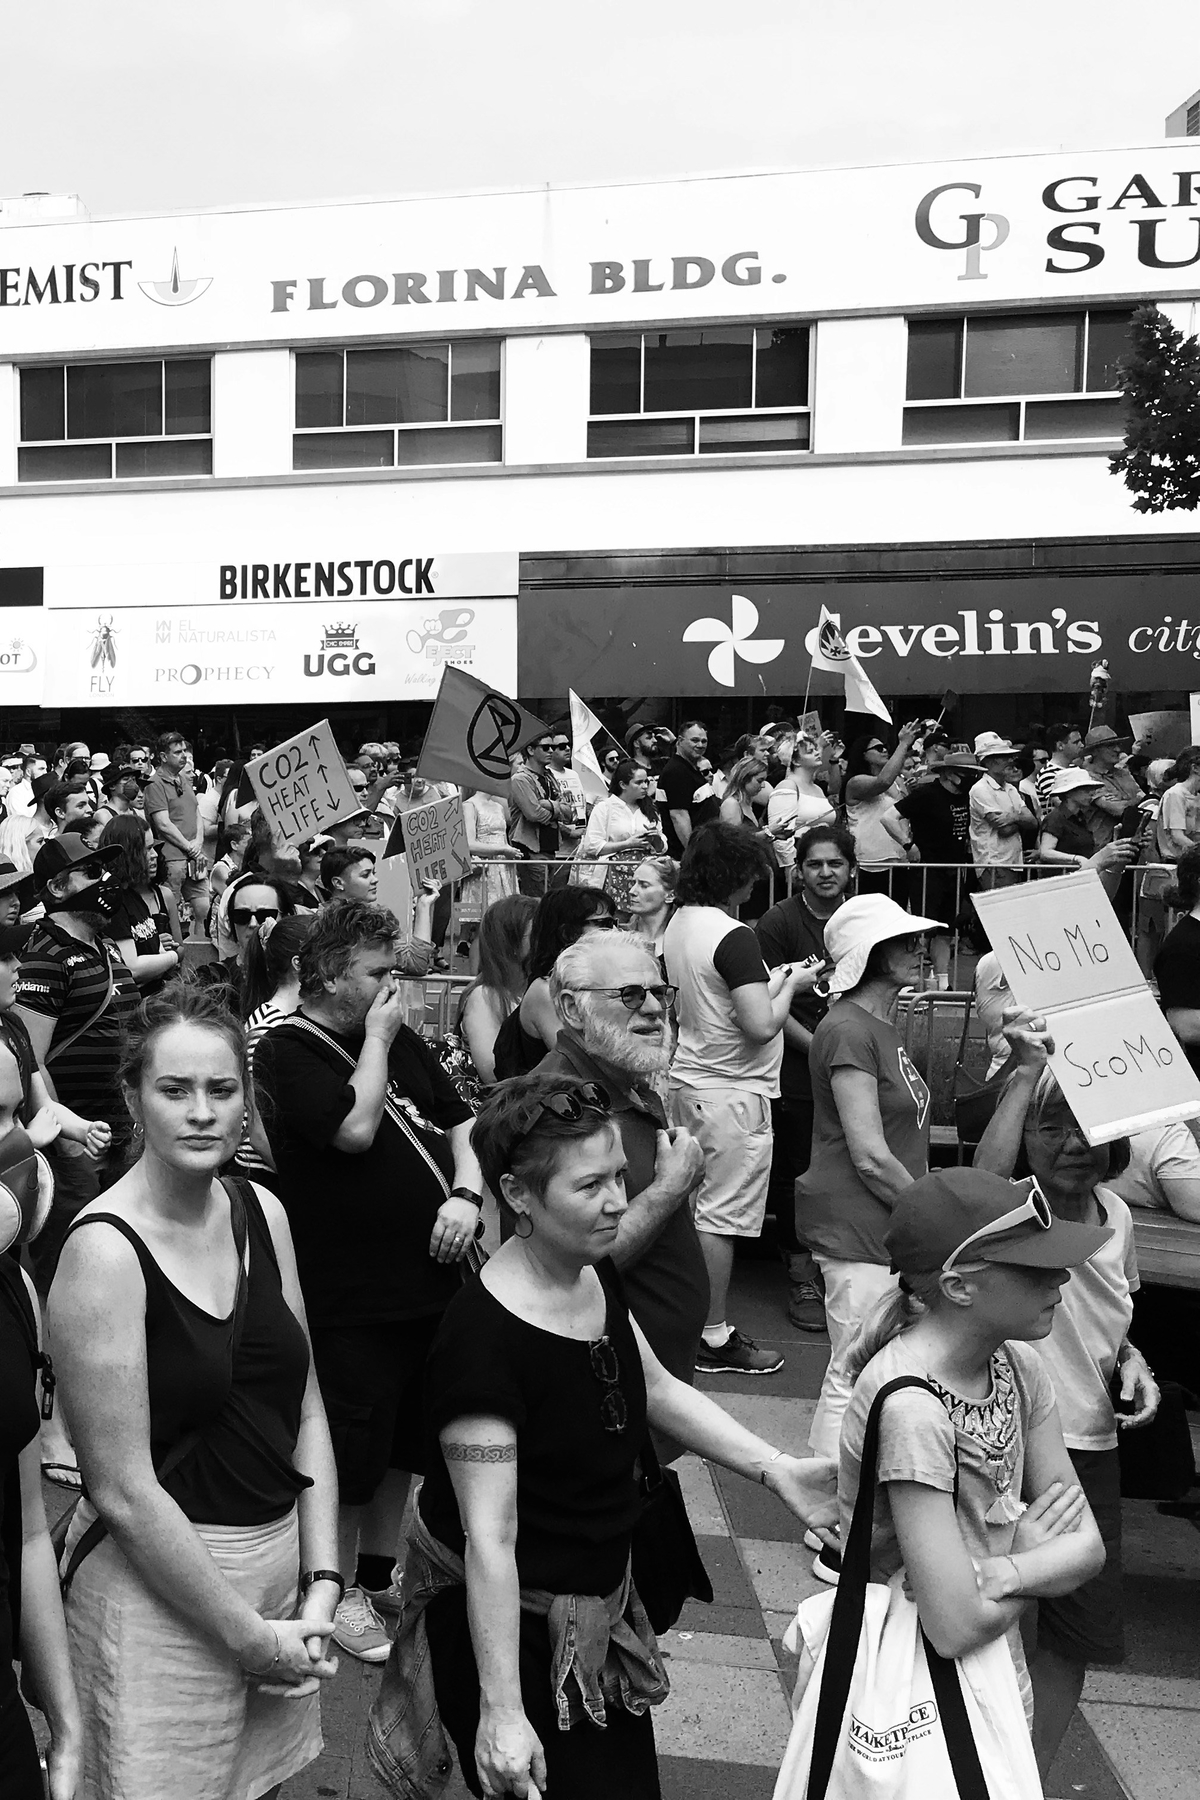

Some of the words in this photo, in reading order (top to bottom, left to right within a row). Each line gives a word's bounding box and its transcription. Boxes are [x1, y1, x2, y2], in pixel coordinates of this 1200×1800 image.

[270, 264, 557, 313] FLORINA
[588, 251, 787, 296] BLDG.
[219, 557, 436, 600] BIRKENSTOCK
[178, 629, 278, 644] NATURALISTA
[179, 619, 198, 632] EL
[153, 663, 276, 686] PROPHECY
[303, 652, 377, 678] UGG
[90, 675, 116, 693] FLY
[258, 745, 309, 790] CO2
[267, 773, 312, 816] HEAT
[277, 805, 325, 841] LIFE
[406, 804, 440, 838] CO2
[410, 829, 448, 864] HEAT
[414, 858, 448, 890] LIFE
[1007, 932, 1062, 975] No
[1063, 1034, 1174, 1088] ScoMo
